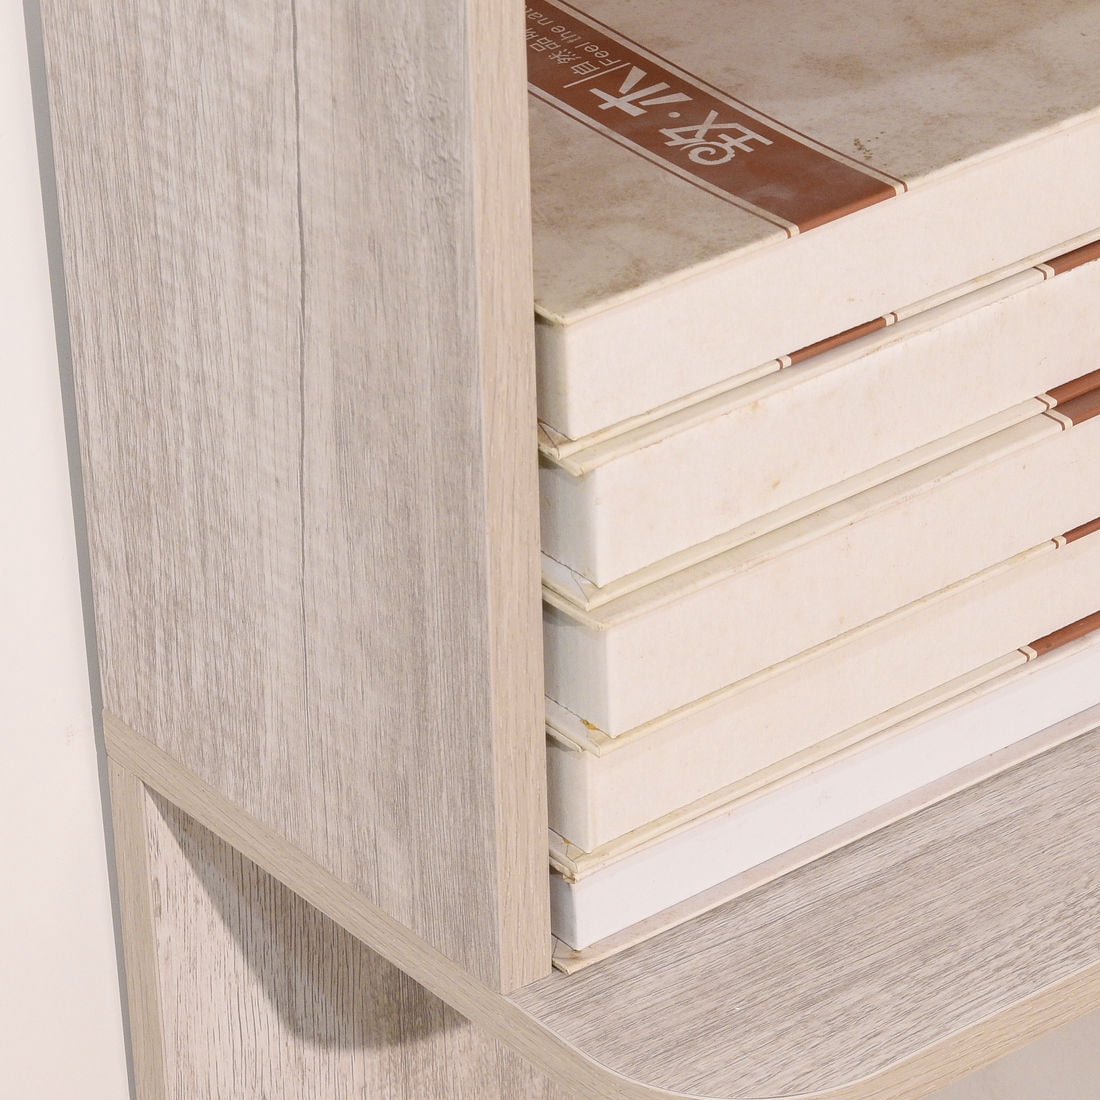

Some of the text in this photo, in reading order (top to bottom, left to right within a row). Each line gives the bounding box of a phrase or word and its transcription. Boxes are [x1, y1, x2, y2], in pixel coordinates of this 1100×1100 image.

[525, 6, 621, 67] Feel the na
